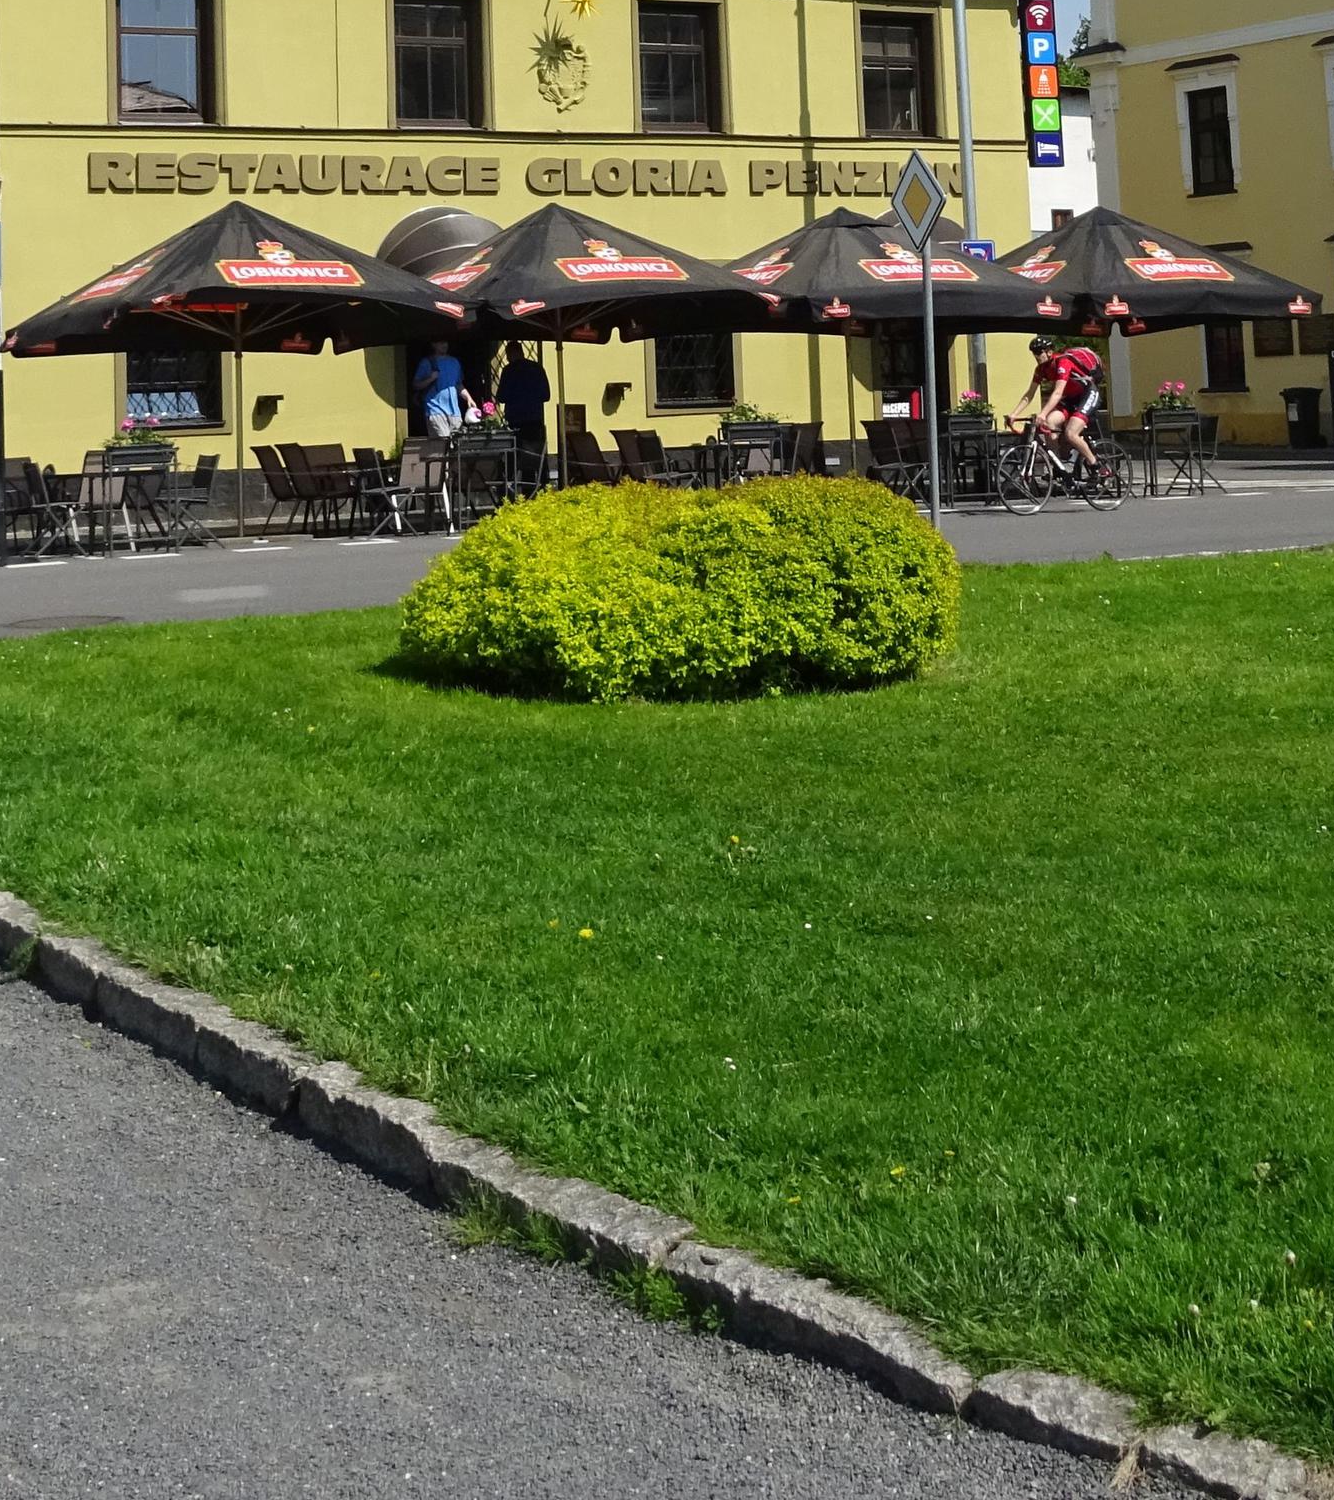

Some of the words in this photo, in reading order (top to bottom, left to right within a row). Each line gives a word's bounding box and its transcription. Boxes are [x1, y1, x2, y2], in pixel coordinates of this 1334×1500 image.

[87, 152, 501, 195] RESTAURACE
[525, 156, 727, 197] GLORIA
[748, 159, 964, 197] PENZIN
[229, 265, 350, 279] LOBKOWICZ
[567, 262, 675, 277] LOBKOWICZ
[1135, 263, 1222, 276] LOBKOWICZ
